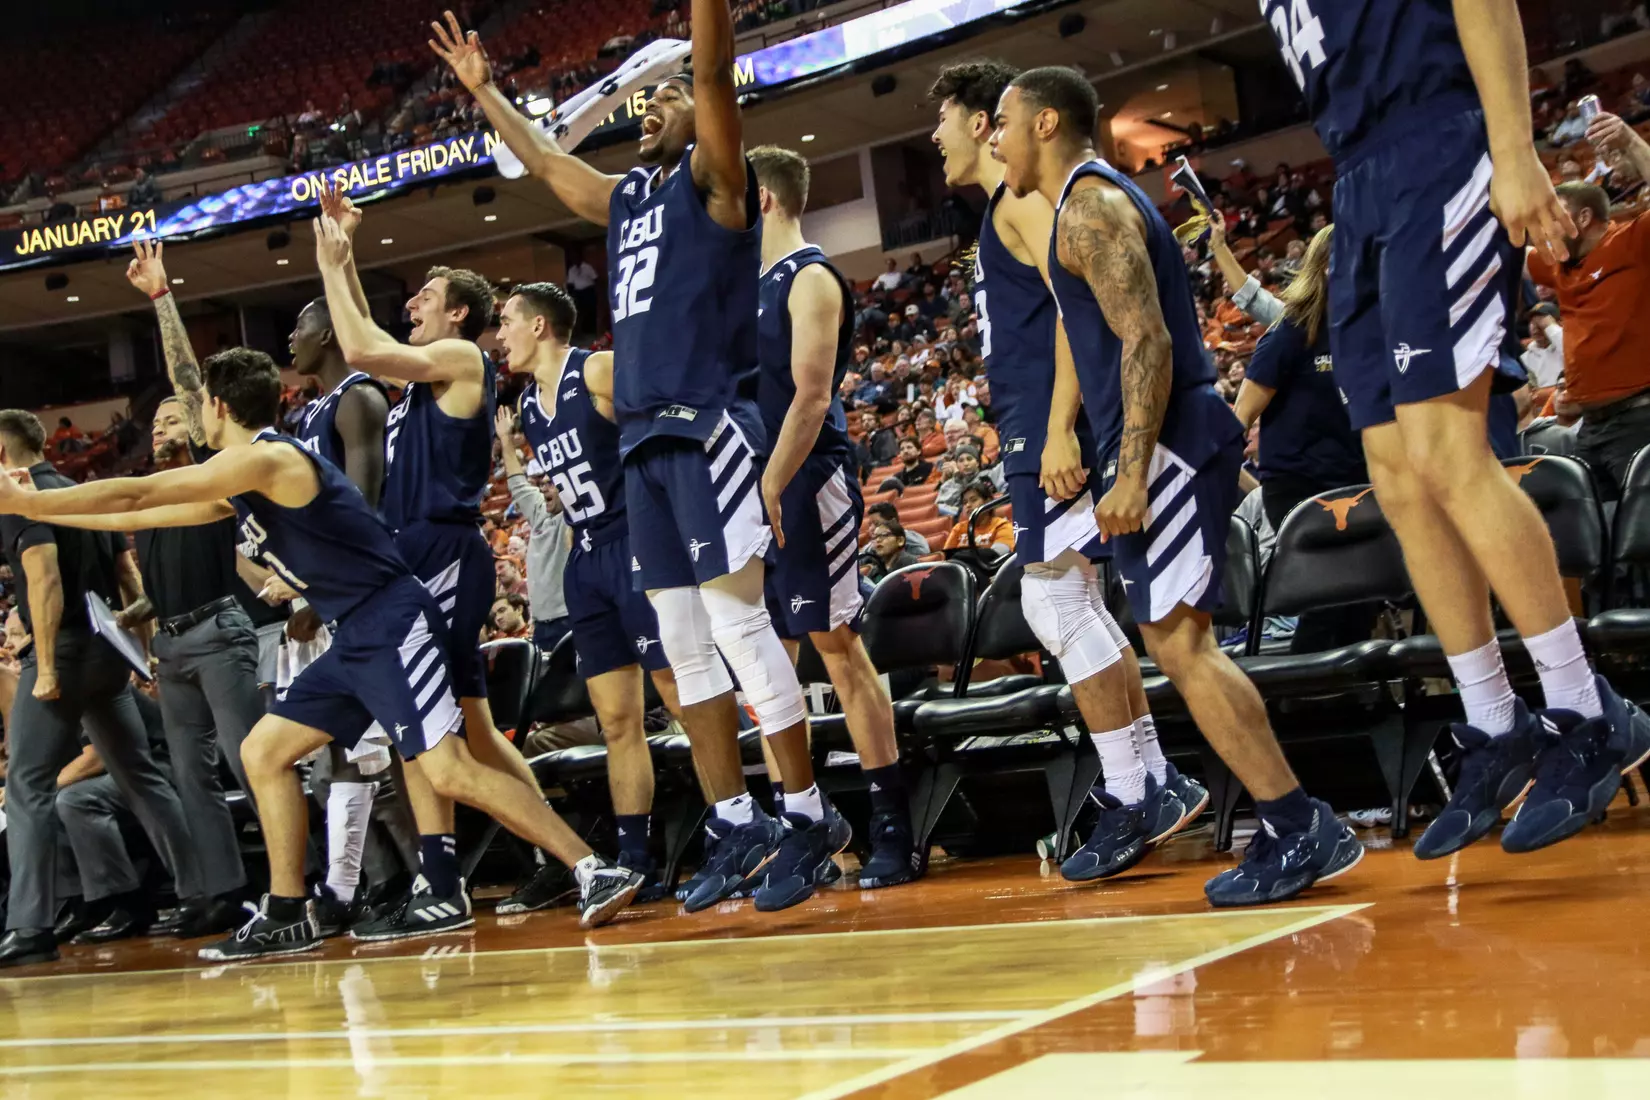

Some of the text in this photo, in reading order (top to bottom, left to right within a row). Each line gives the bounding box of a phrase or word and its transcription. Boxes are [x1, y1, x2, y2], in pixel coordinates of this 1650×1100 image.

[291, 172, 327, 201] ON
[333, 157, 392, 192] SALE
[397, 135, 479, 178] FRIDAY,
[15, 209, 157, 255] JANUARY 21
[618, 203, 665, 254] CBU
[612, 246, 659, 323] 32
[537, 427, 583, 473] CBU
[552, 460, 605, 523] 25
